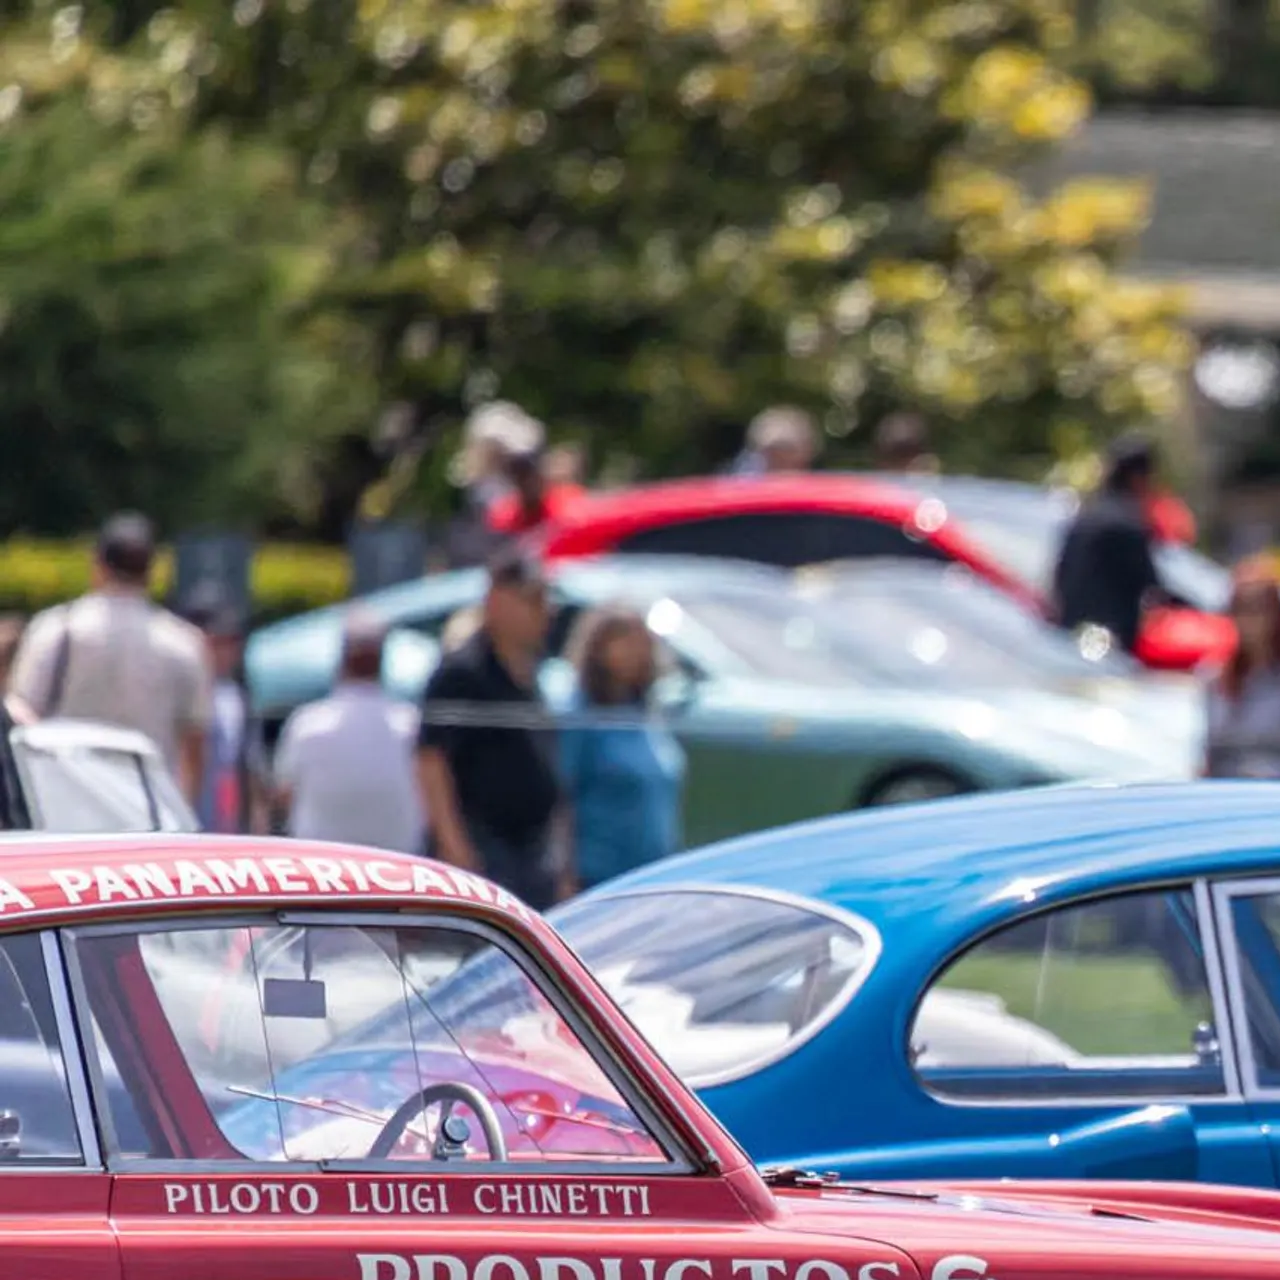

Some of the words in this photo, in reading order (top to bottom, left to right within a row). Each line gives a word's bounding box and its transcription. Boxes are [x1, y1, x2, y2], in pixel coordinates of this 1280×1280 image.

[48, 856, 534, 924] PANAMERICANA
[163, 1183, 319, 1214] PILOTO
[346, 1183, 450, 1214] LUIGI
[473, 1184, 651, 1215] CHINETTI
